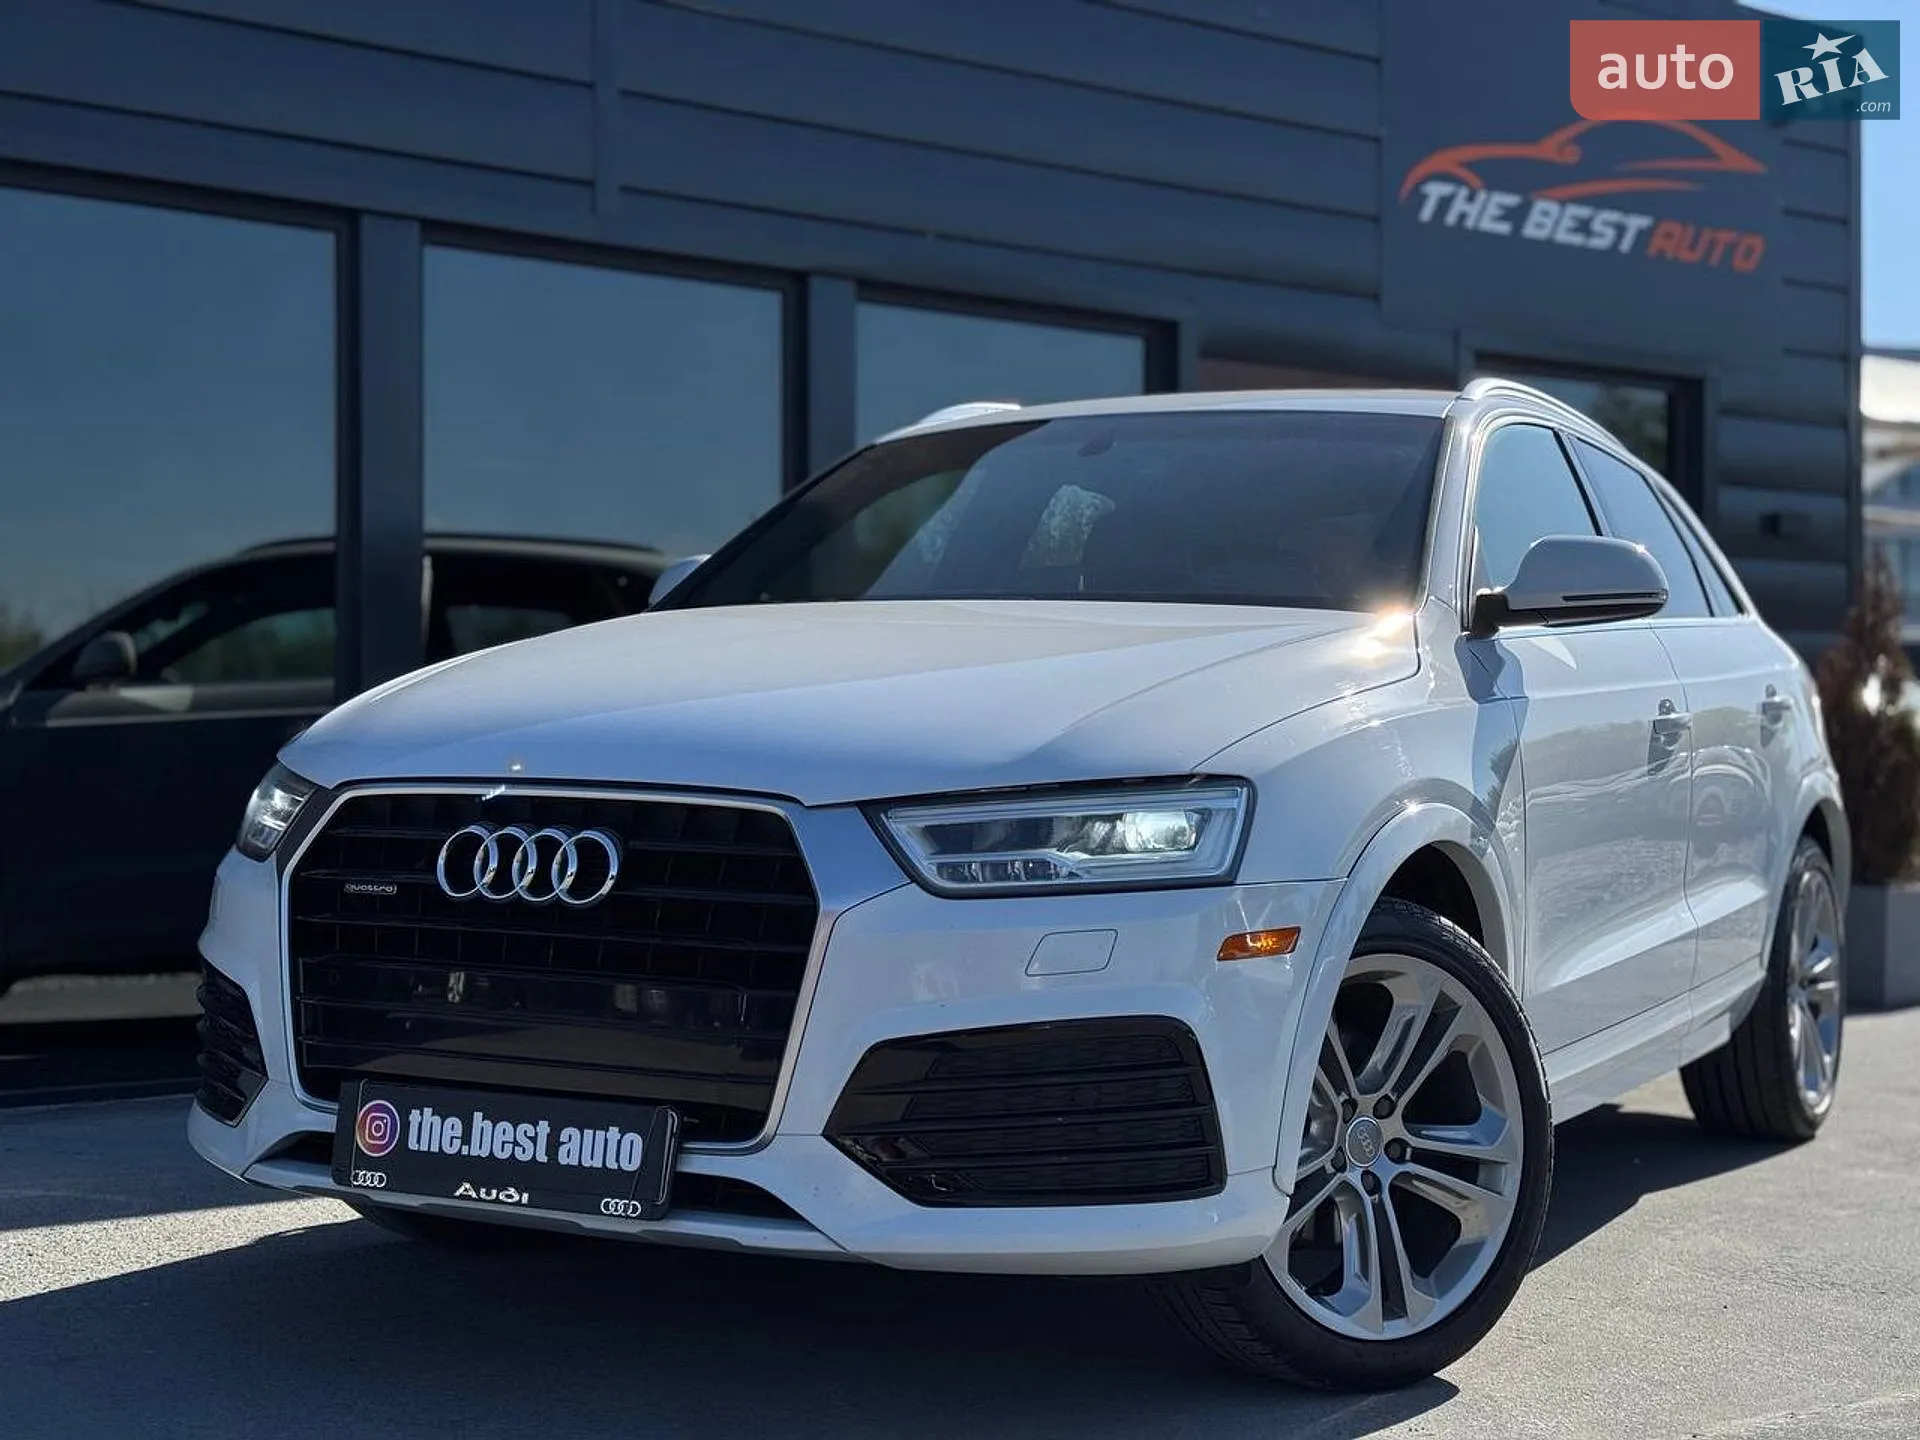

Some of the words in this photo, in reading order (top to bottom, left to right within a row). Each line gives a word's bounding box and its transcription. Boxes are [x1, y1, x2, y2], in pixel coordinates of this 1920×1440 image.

[1417, 181, 1519, 236] THE
[1520, 198, 1653, 255] BEST
[1646, 220, 1766, 273] AUTO
[408, 1107, 550, 1163] the.best
[559, 1126, 643, 1172] auto
[454, 1182, 529, 1204] Audi
